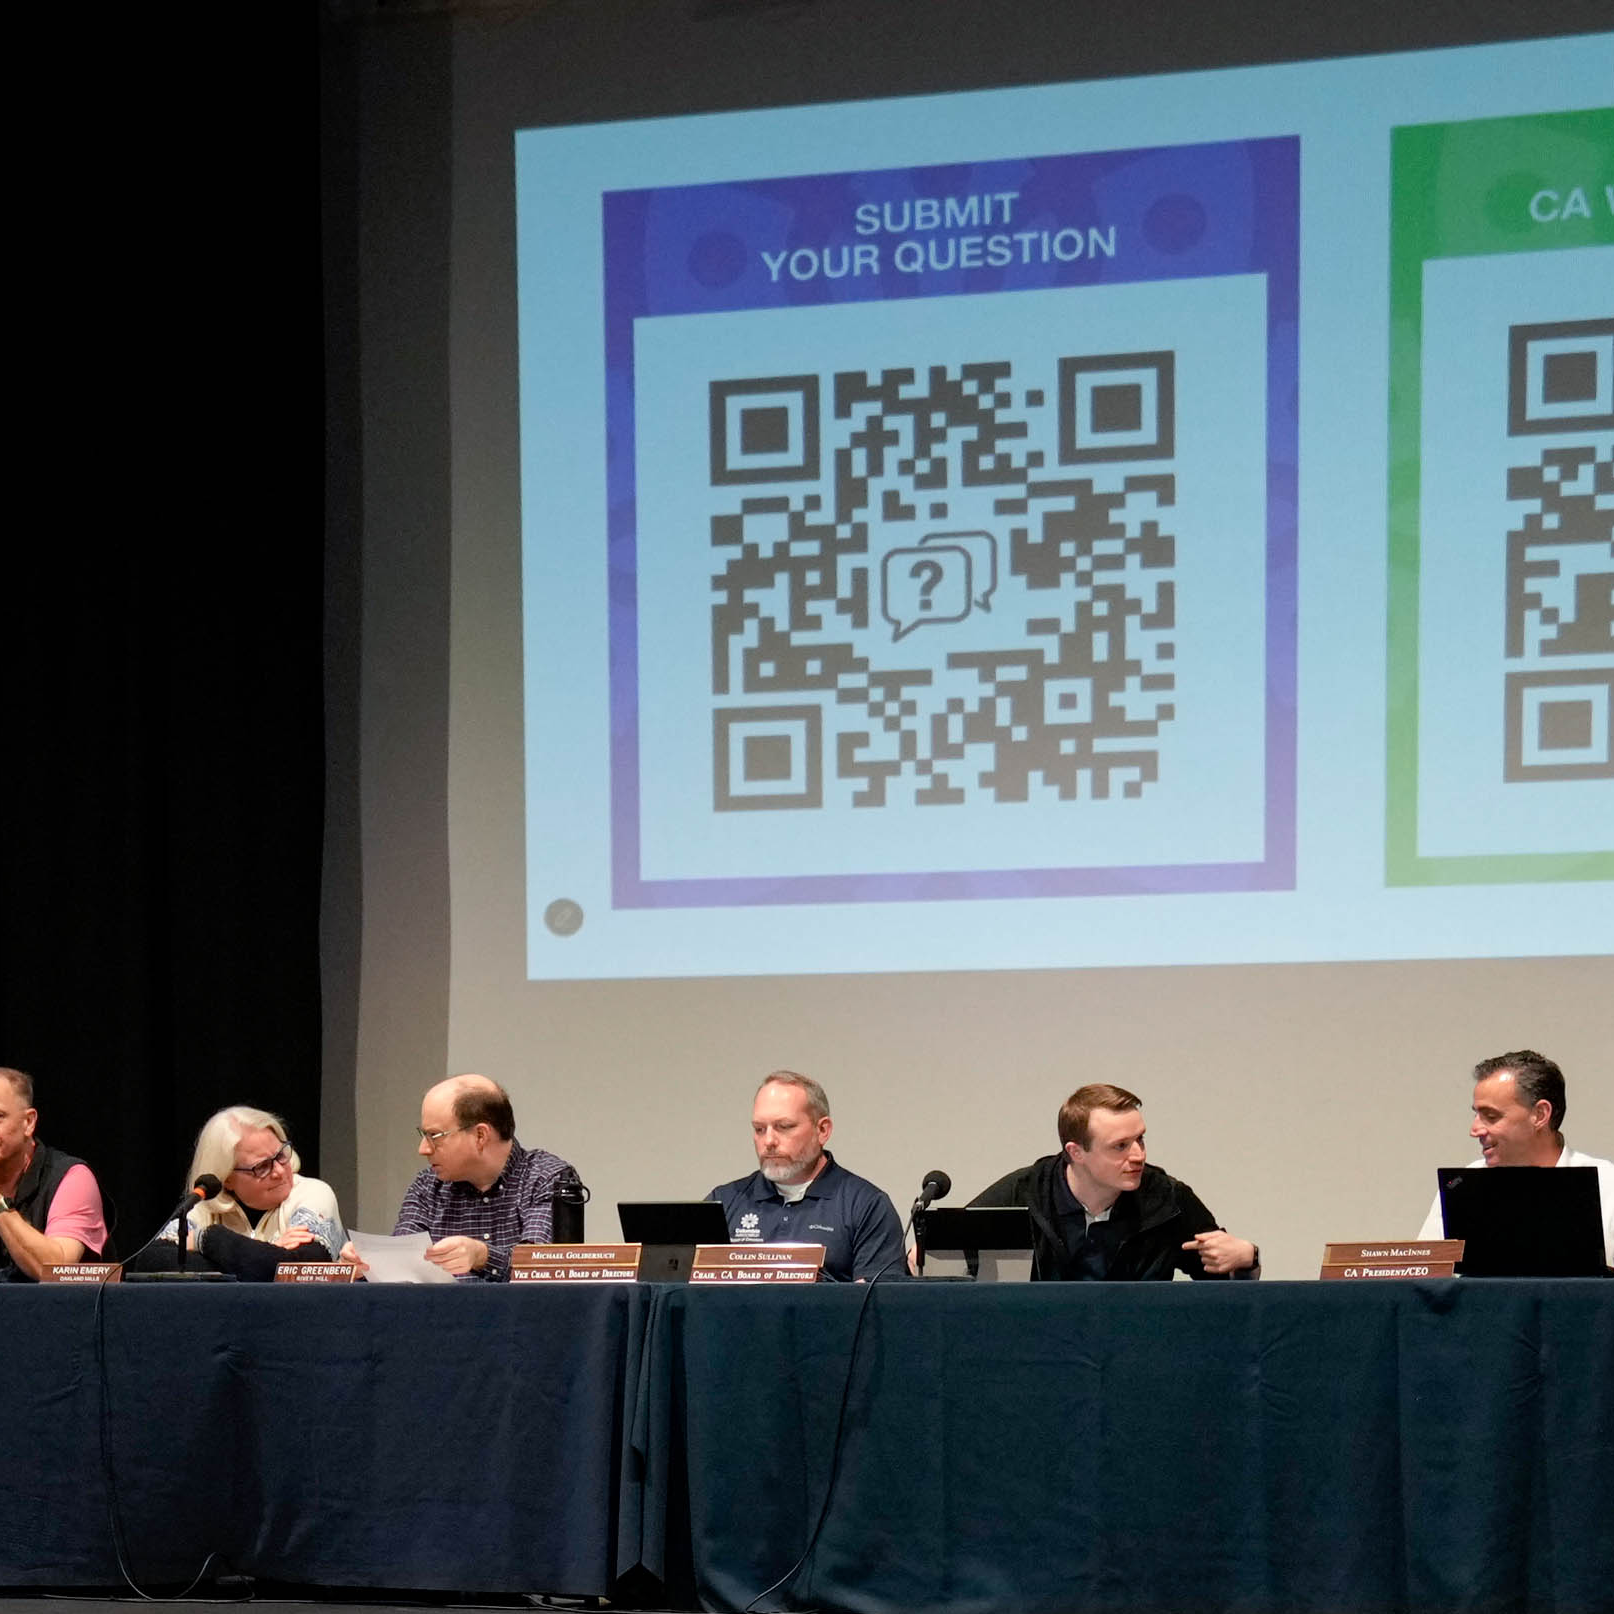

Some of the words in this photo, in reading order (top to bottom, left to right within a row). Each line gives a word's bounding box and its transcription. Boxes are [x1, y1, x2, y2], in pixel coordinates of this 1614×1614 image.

[1529, 190, 1591, 222] CA
[855, 191, 1019, 235] SUBMIT
[761, 244, 880, 282] YOUR
[894, 226, 1116, 274] QUESTION
[909, 560, 944, 611] ?
[52, 1266, 79, 1274] KARIN
[80, 1266, 110, 1274] EMERY
[277, 1266, 298, 1275] ERIC
[301, 1266, 351, 1275] GREENBERG
[555, 1270, 565, 1278] CA
[721, 1270, 733, 1279] CA
[1344, 1268, 1358, 1277] CA
